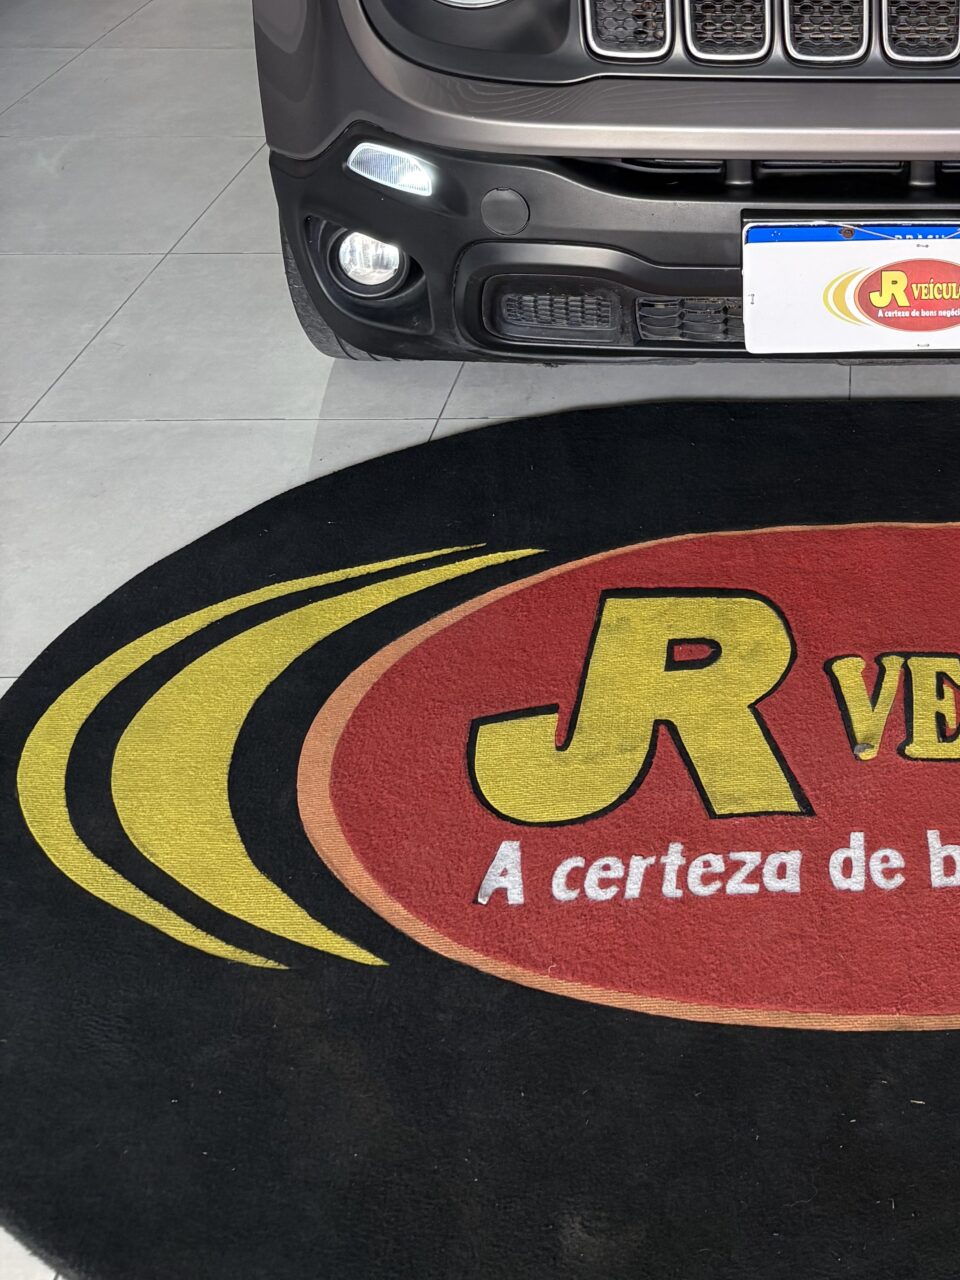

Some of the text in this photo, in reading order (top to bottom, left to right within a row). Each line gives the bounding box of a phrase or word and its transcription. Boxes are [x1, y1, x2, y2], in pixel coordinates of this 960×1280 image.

[869, 270, 911, 308] JR
[878, 309, 884, 317] A
[911, 308, 919, 317] de
[920, 308, 937, 317] bons
[467, 587, 815, 827] JR
[474, 840, 524, 906] A
[550, 841, 803, 902] certeza
[828, 831, 907, 891] de
